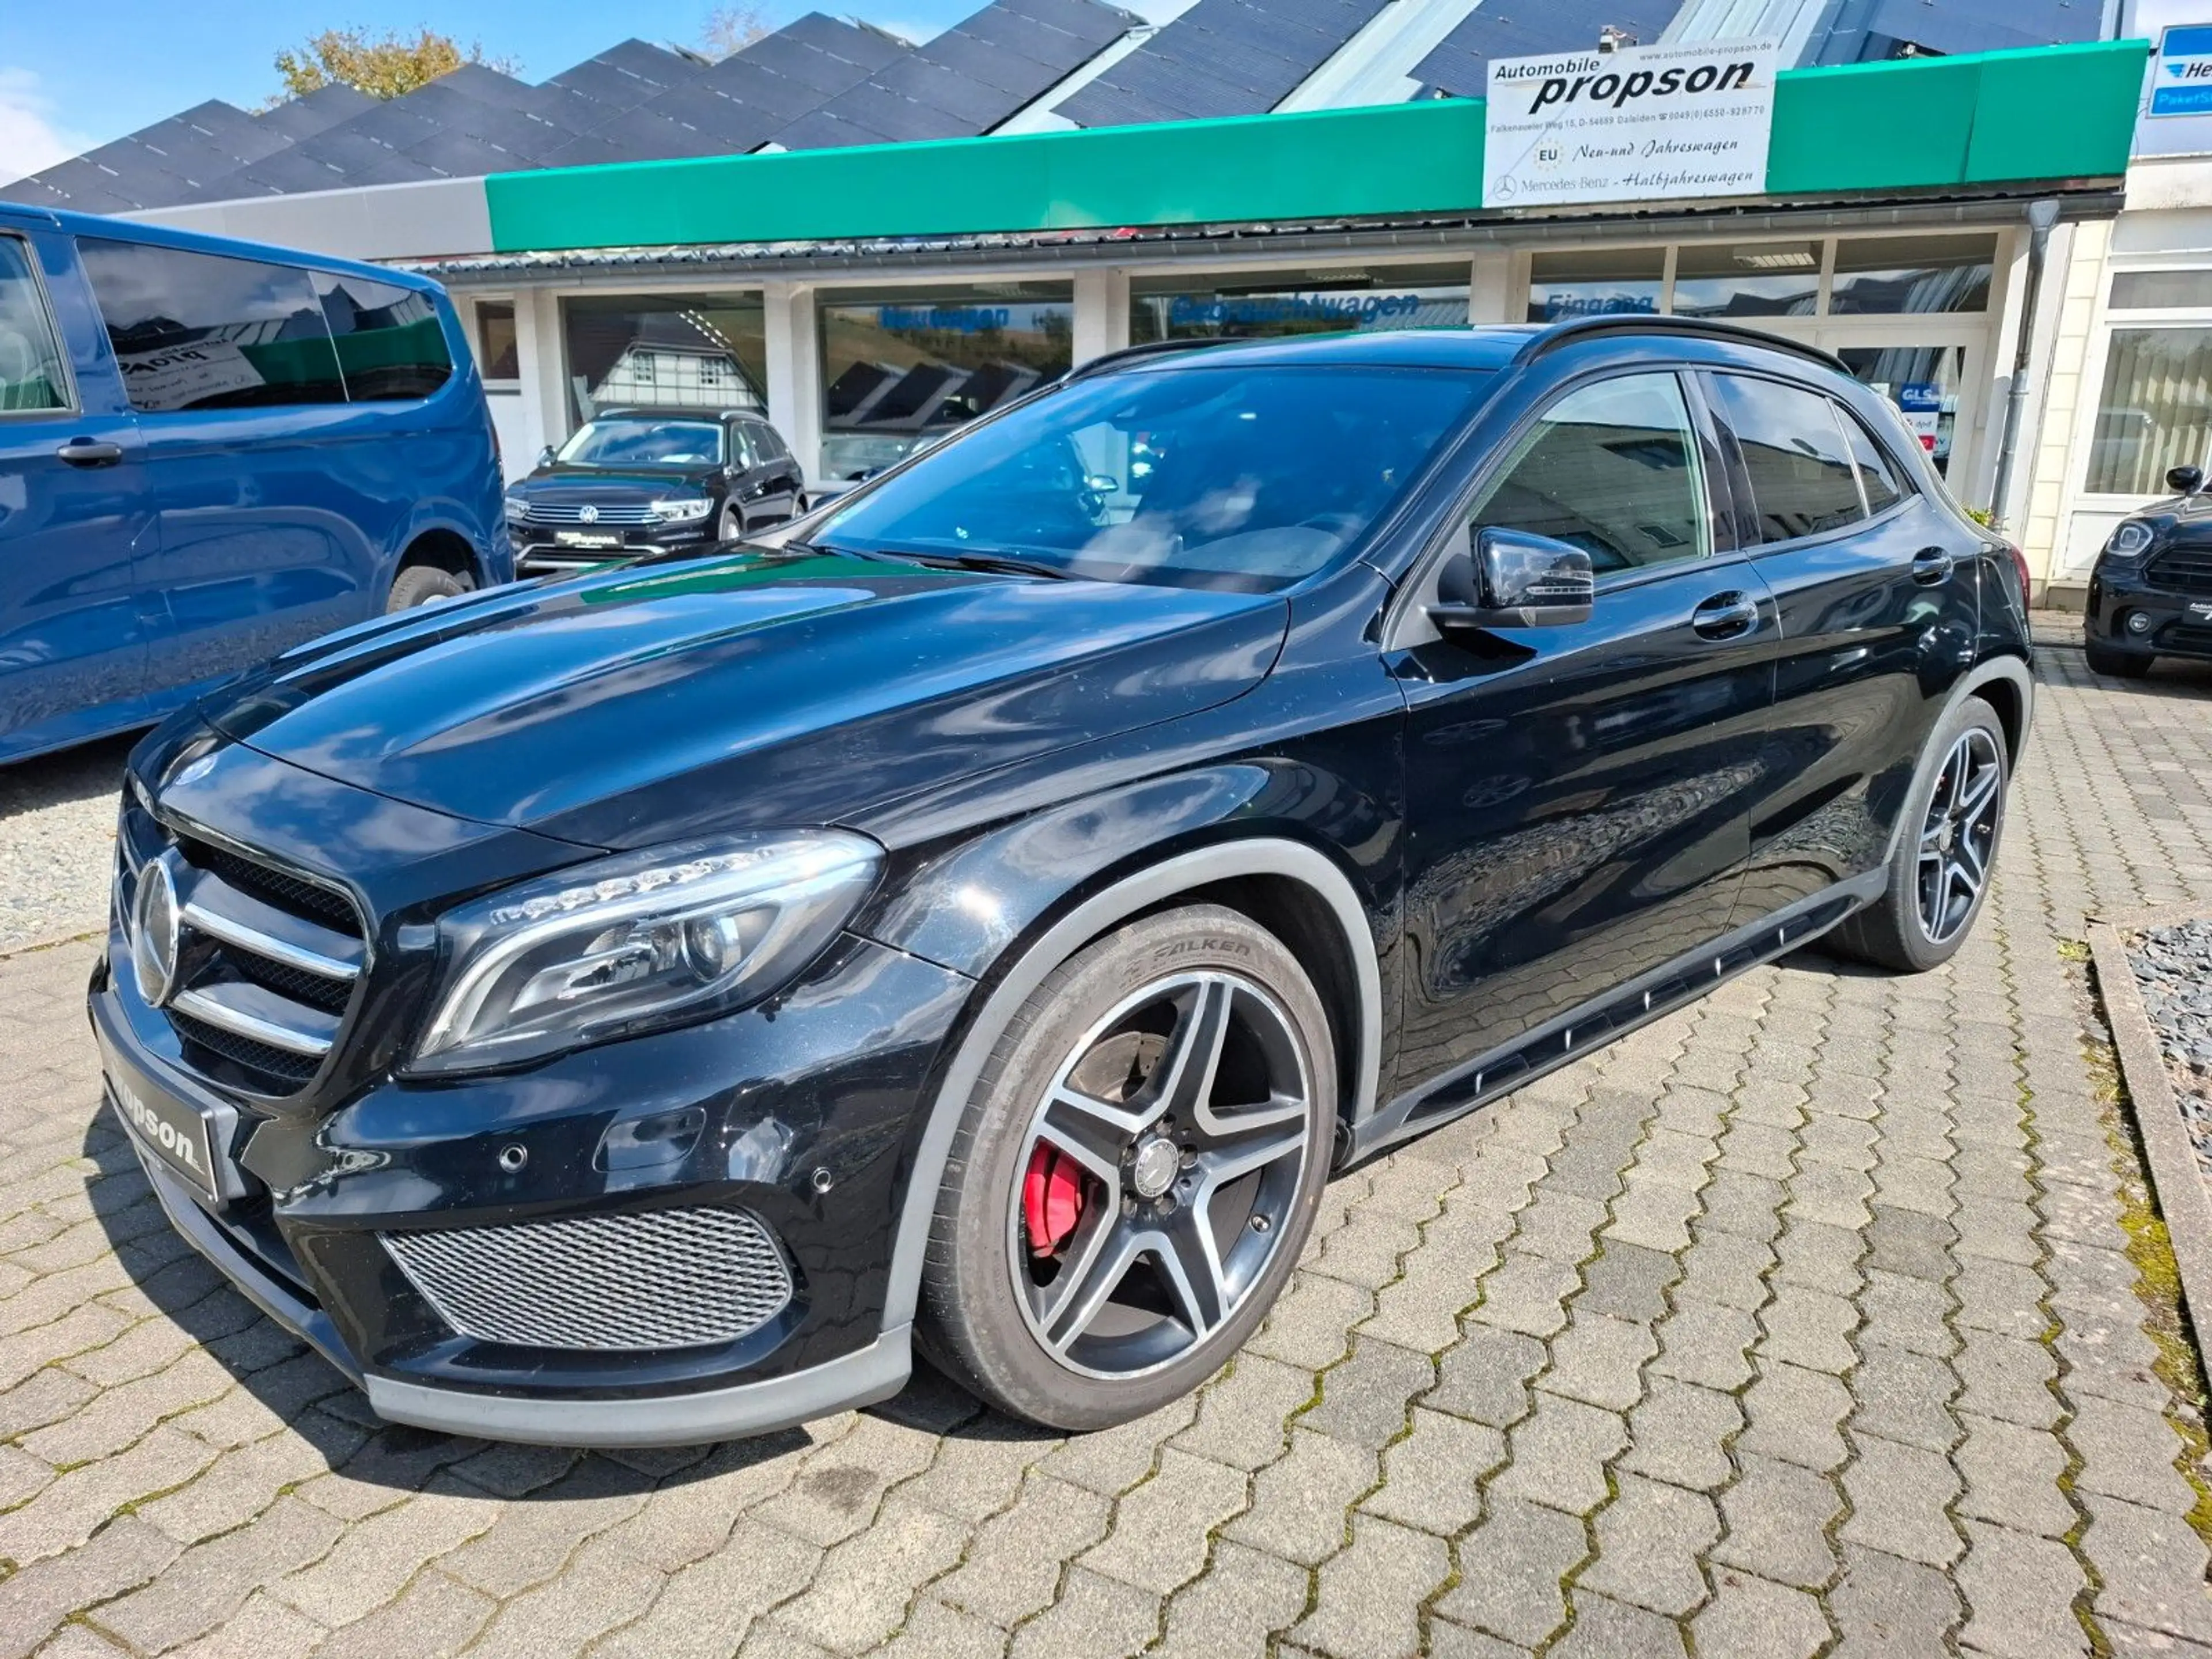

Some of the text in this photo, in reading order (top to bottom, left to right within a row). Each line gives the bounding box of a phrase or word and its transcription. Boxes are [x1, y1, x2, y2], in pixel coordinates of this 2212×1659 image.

[1495, 57, 1600, 79] Automobile
[2186, 62, 2212, 78] He
[1528, 61, 1755, 115] propson
[1617, 113, 1656, 124] Daleiden
[1539, 149, 1558, 161] EU
[1641, 139, 1738, 159] Jahreswagen
[1544, 293, 1654, 320] Eingang
[1902, 388, 1932, 401] GLS
